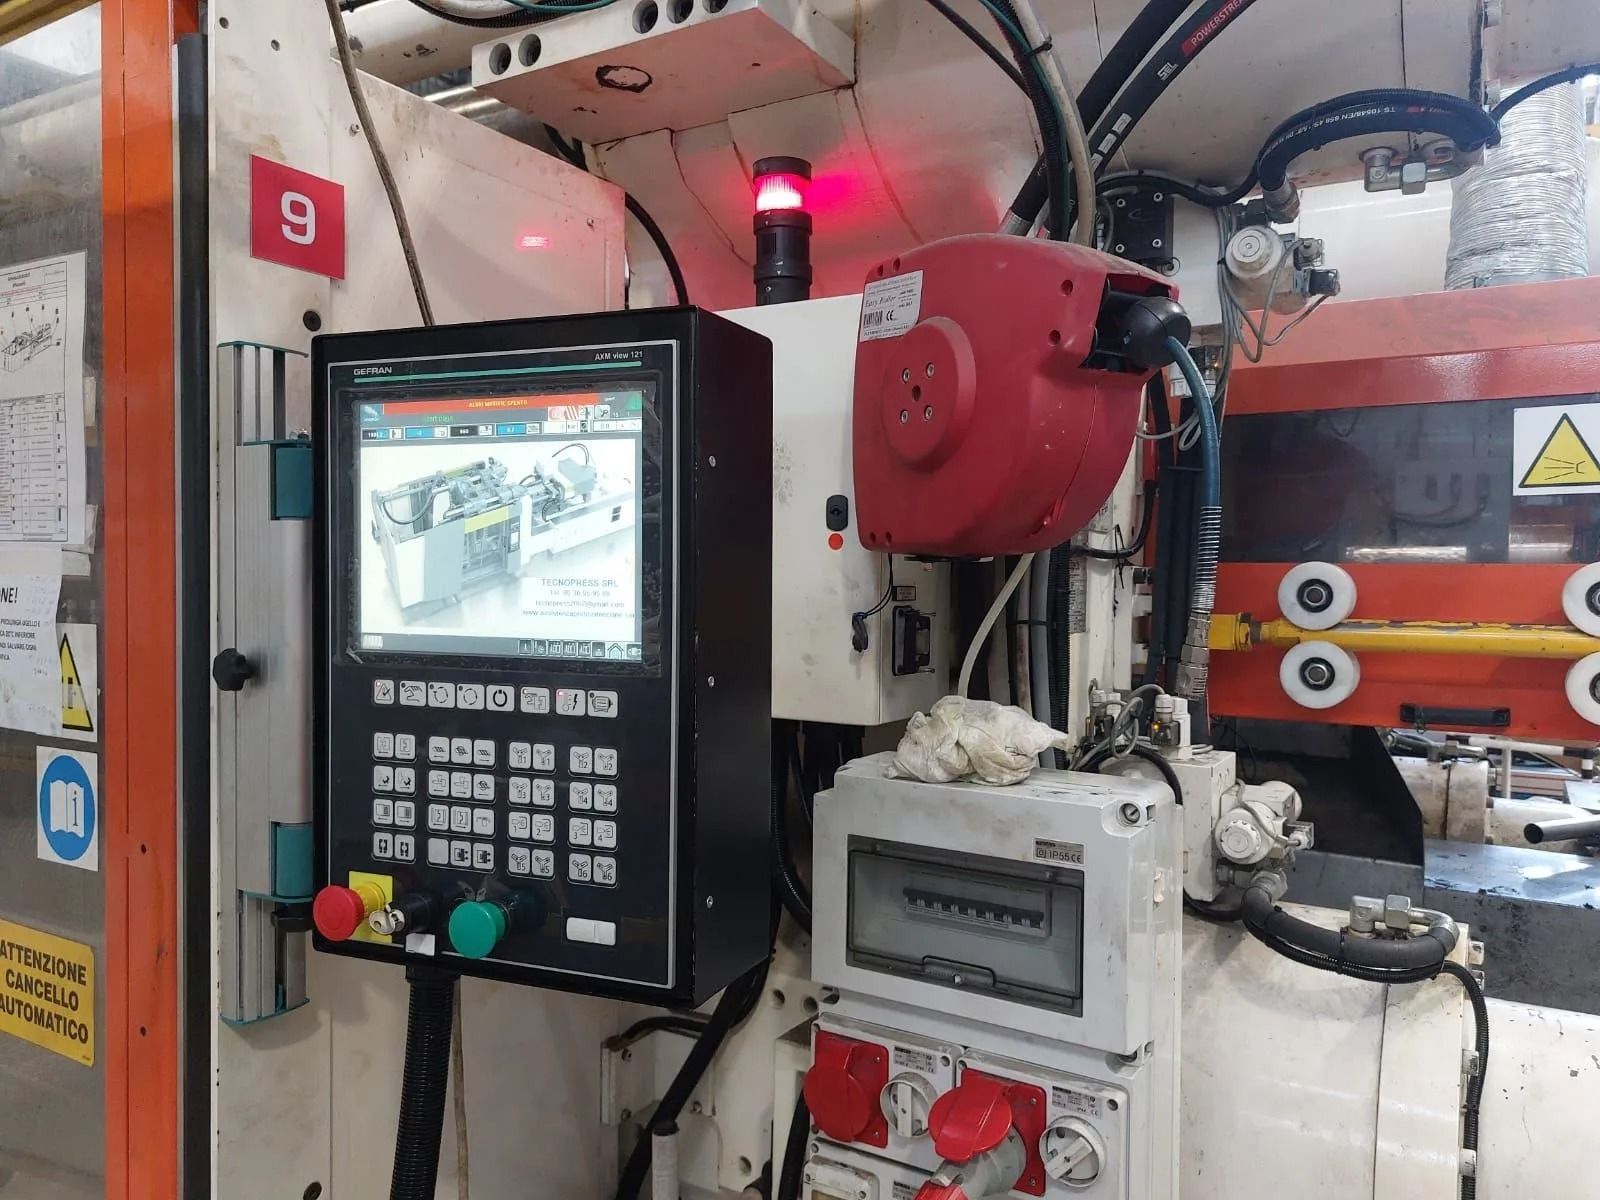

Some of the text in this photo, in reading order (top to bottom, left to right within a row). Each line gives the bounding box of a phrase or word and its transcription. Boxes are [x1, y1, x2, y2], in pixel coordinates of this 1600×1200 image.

[1191, 0, 1241, 46] POWERSTRE
[281, 191, 316, 245] 9
[353, 366, 393, 376] GEFRAN
[0, 586, 18, 604] NE!
[541, 578, 600, 587] TECNOPRESS
[1049, 849, 1070, 861] IP55
[0, 939, 87, 986] ATTENZIONE
[6, 968, 79, 1012] CANCELLO
[0, 993, 89, 1045] AUTOMATICO
